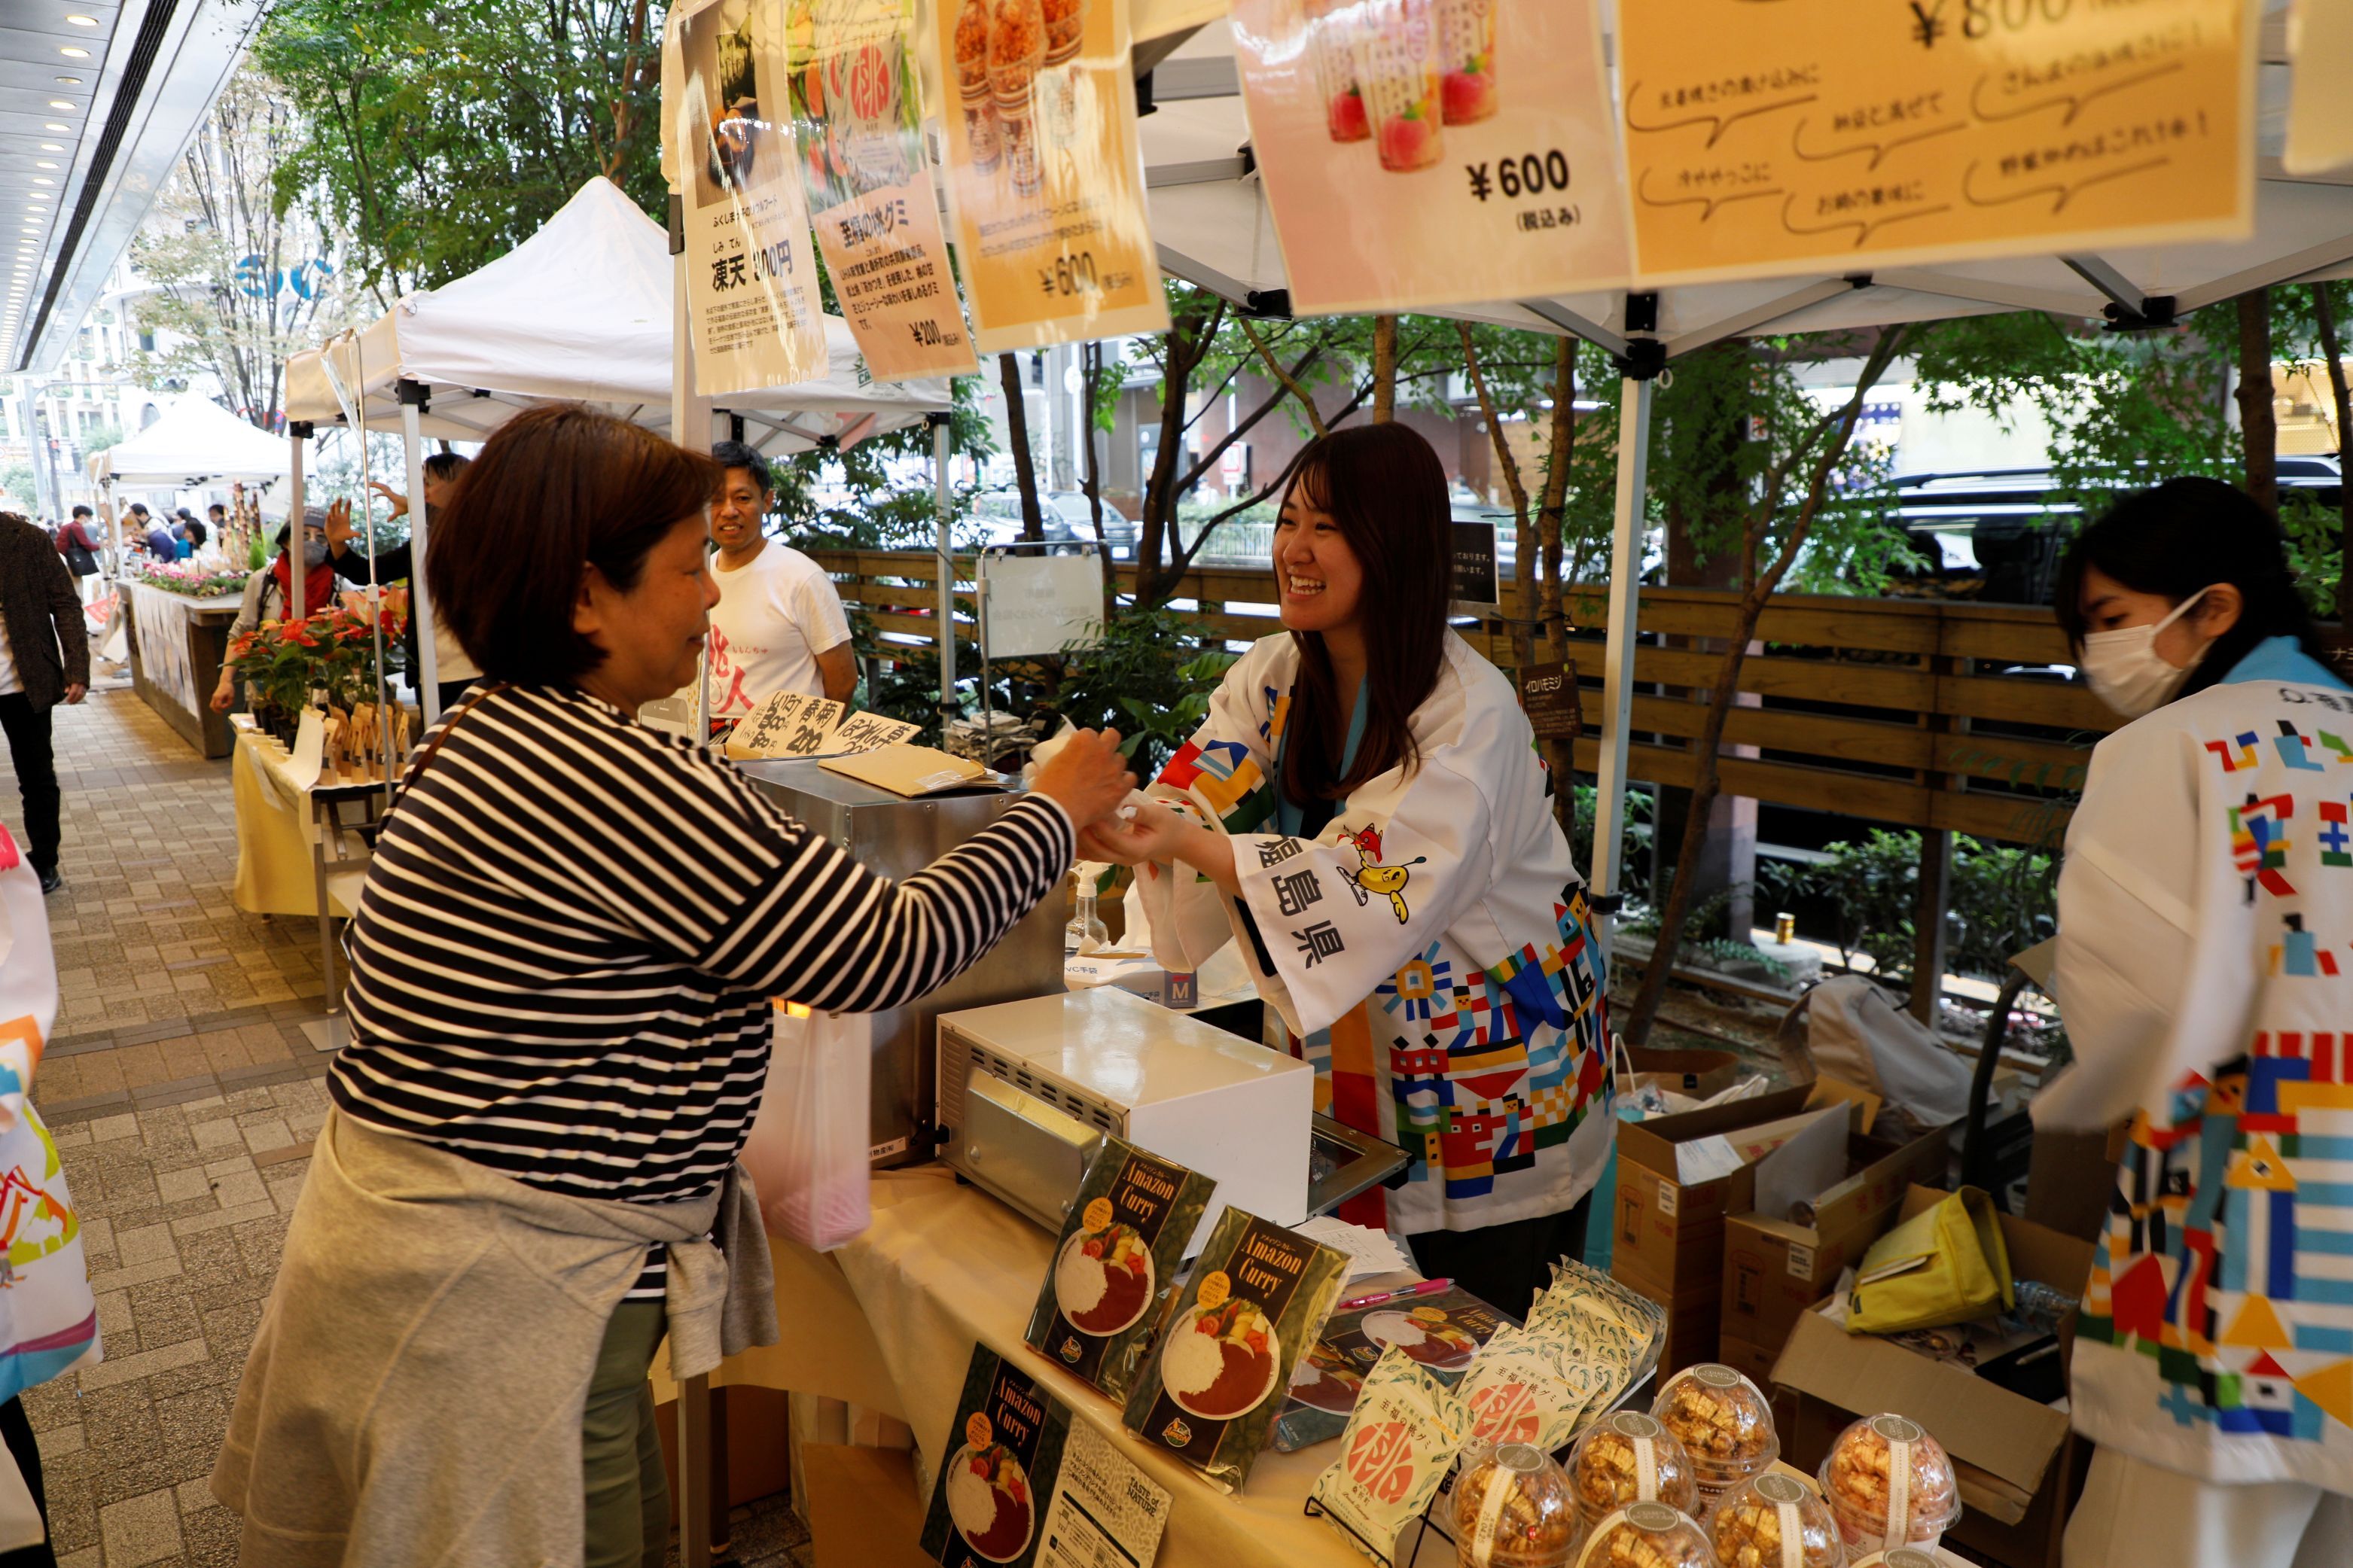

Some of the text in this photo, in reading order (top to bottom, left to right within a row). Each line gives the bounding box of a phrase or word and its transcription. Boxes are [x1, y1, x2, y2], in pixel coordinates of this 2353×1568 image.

[1466, 149, 1571, 202] ¥600
[839, 199, 910, 248] 至福の桃グミ
[1516, 205, 1581, 232] (税込み)
[908, 319, 942, 347] ¥200
[1525, 674, 1562, 694] イロハモミジ
[1254, 836, 1346, 970] 福島県
[1172, 982, 1189, 1000] M
[1123, 1160, 1175, 1201] Amazon
[1120, 1184, 1159, 1224] Curry
[1240, 1231, 1303, 1275] Amazon
[1239, 1257, 1283, 1299] Curry
[995, 1375, 1041, 1426] Amazon
[1495, 1366, 1557, 1403] 至福の桃グミ
[997, 1402, 1030, 1448] Curry
[1379, 1397, 1431, 1451] 至福の桃グミ
[1347, 1421, 1414, 1506] 桃
[1126, 1486, 1157, 1518] NATURE
[1130, 1476, 1160, 1508] TASTE of
